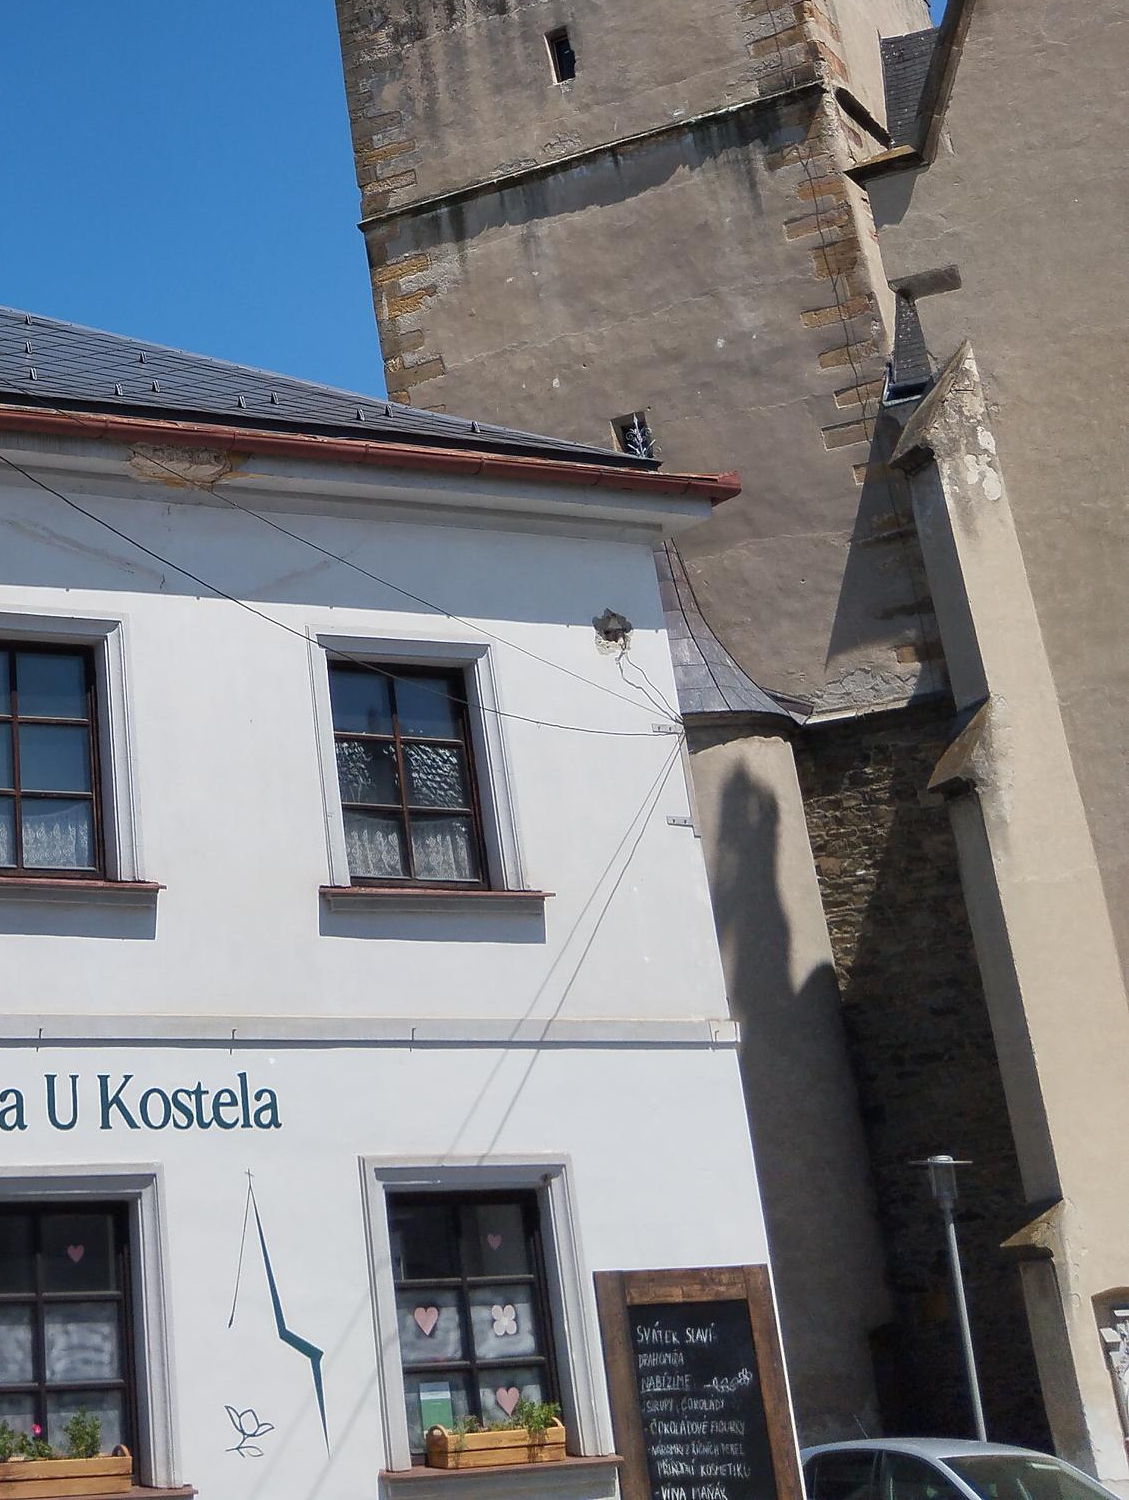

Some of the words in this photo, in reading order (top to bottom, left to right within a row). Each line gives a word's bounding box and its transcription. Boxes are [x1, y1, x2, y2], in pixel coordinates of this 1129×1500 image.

[44, 1073, 80, 1131] U
[96, 1070, 283, 1131] Kostela
[636, 1321, 680, 1345] SVÁTEK
